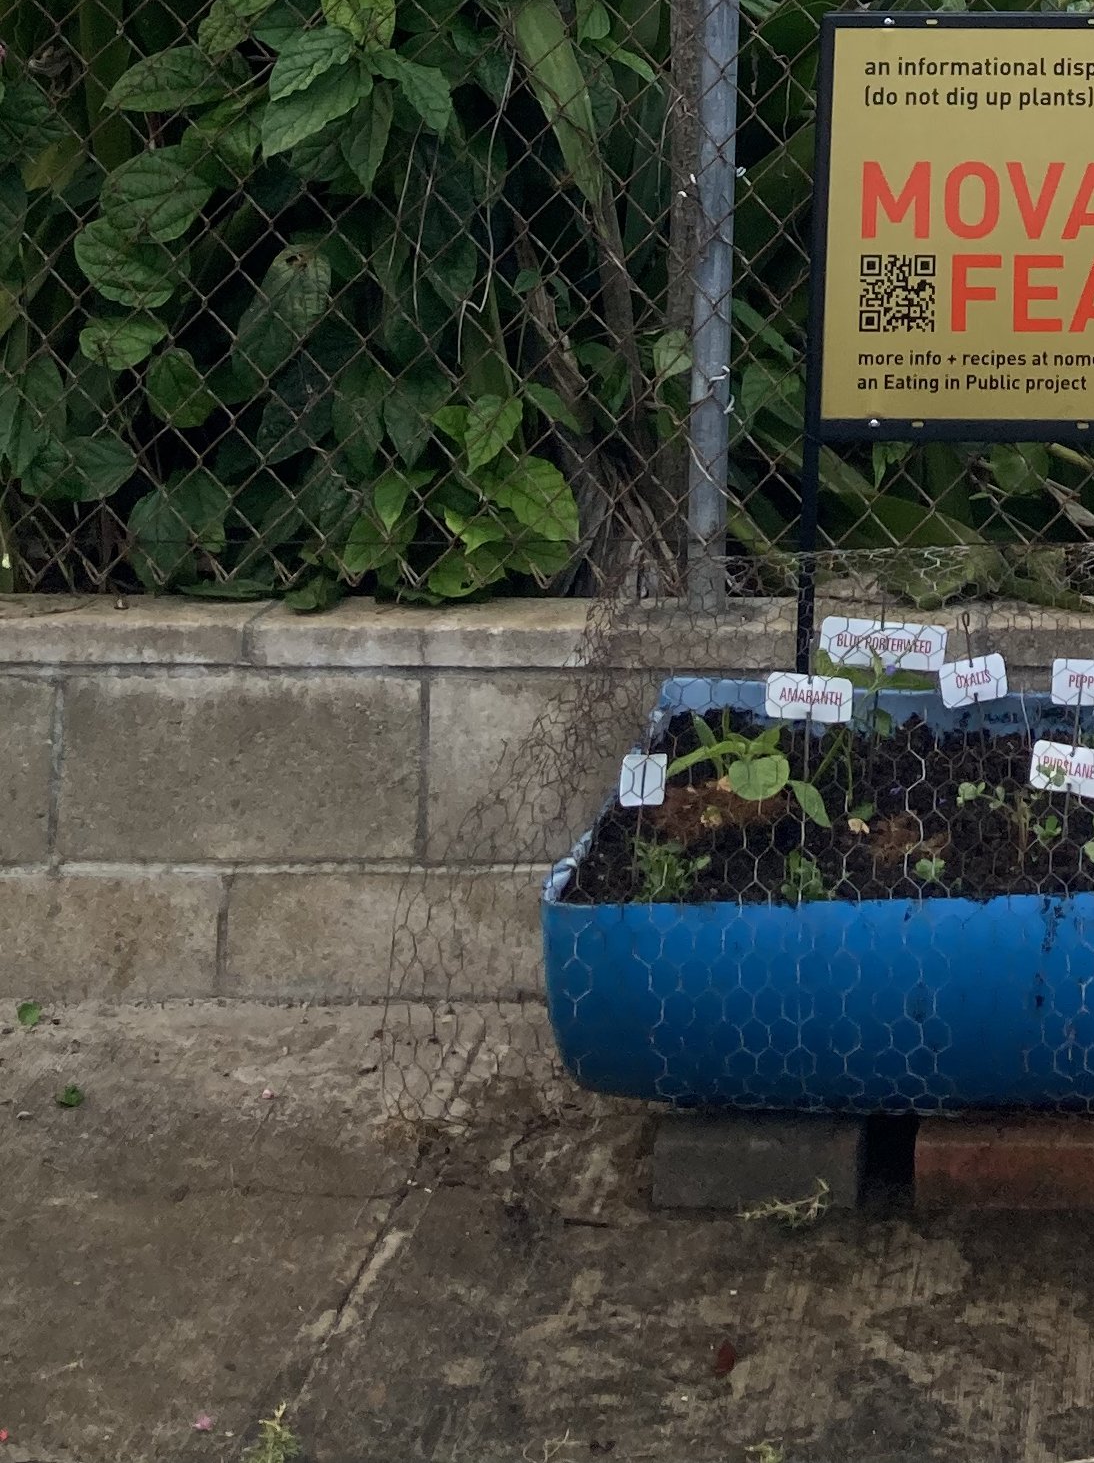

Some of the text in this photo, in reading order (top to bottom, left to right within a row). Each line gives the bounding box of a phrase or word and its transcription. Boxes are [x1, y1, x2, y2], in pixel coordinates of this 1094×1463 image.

[864, 61, 890, 76] an
[898, 56, 1047, 77] informational
[864, 85, 1094, 111] (do not dig up plants)
[858, 353, 904, 367] more
[909, 349, 942, 367] info
[962, 349, 1027, 370] recipes
[1031, 351, 1049, 367] at
[857, 373, 1087, 394] an Eating in Public project
[955, 669, 992, 689] OXALIS
[779, 686, 843, 706] AMARANTH
